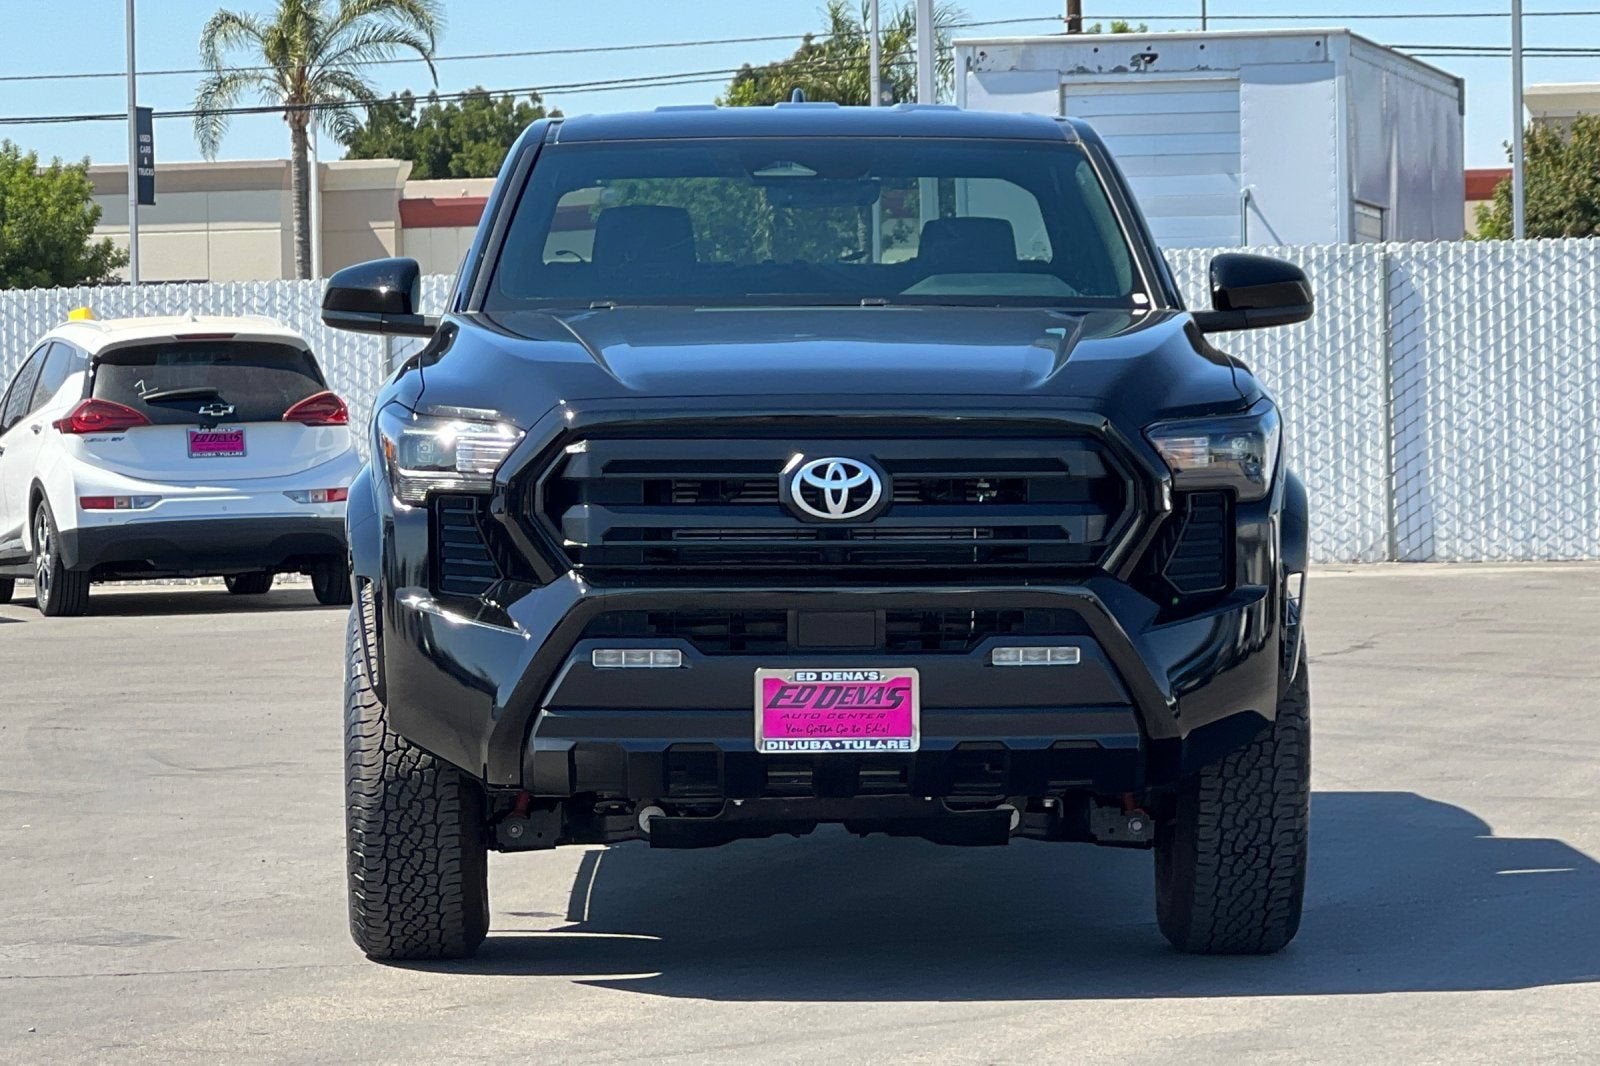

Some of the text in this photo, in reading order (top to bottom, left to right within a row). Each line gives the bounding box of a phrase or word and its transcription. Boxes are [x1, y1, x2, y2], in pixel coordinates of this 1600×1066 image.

[139, 145, 151, 153] CARS
[138, 167, 154, 176] TRUCKS
[796, 671, 879, 681] ED DENA'S
[766, 685, 912, 709] ED DENA'S
[780, 712, 887, 720] AUTO CENTER
[785, 722, 890, 734] You Gotta Go to Ed's!
[842, 740, 911, 750] TULARE
